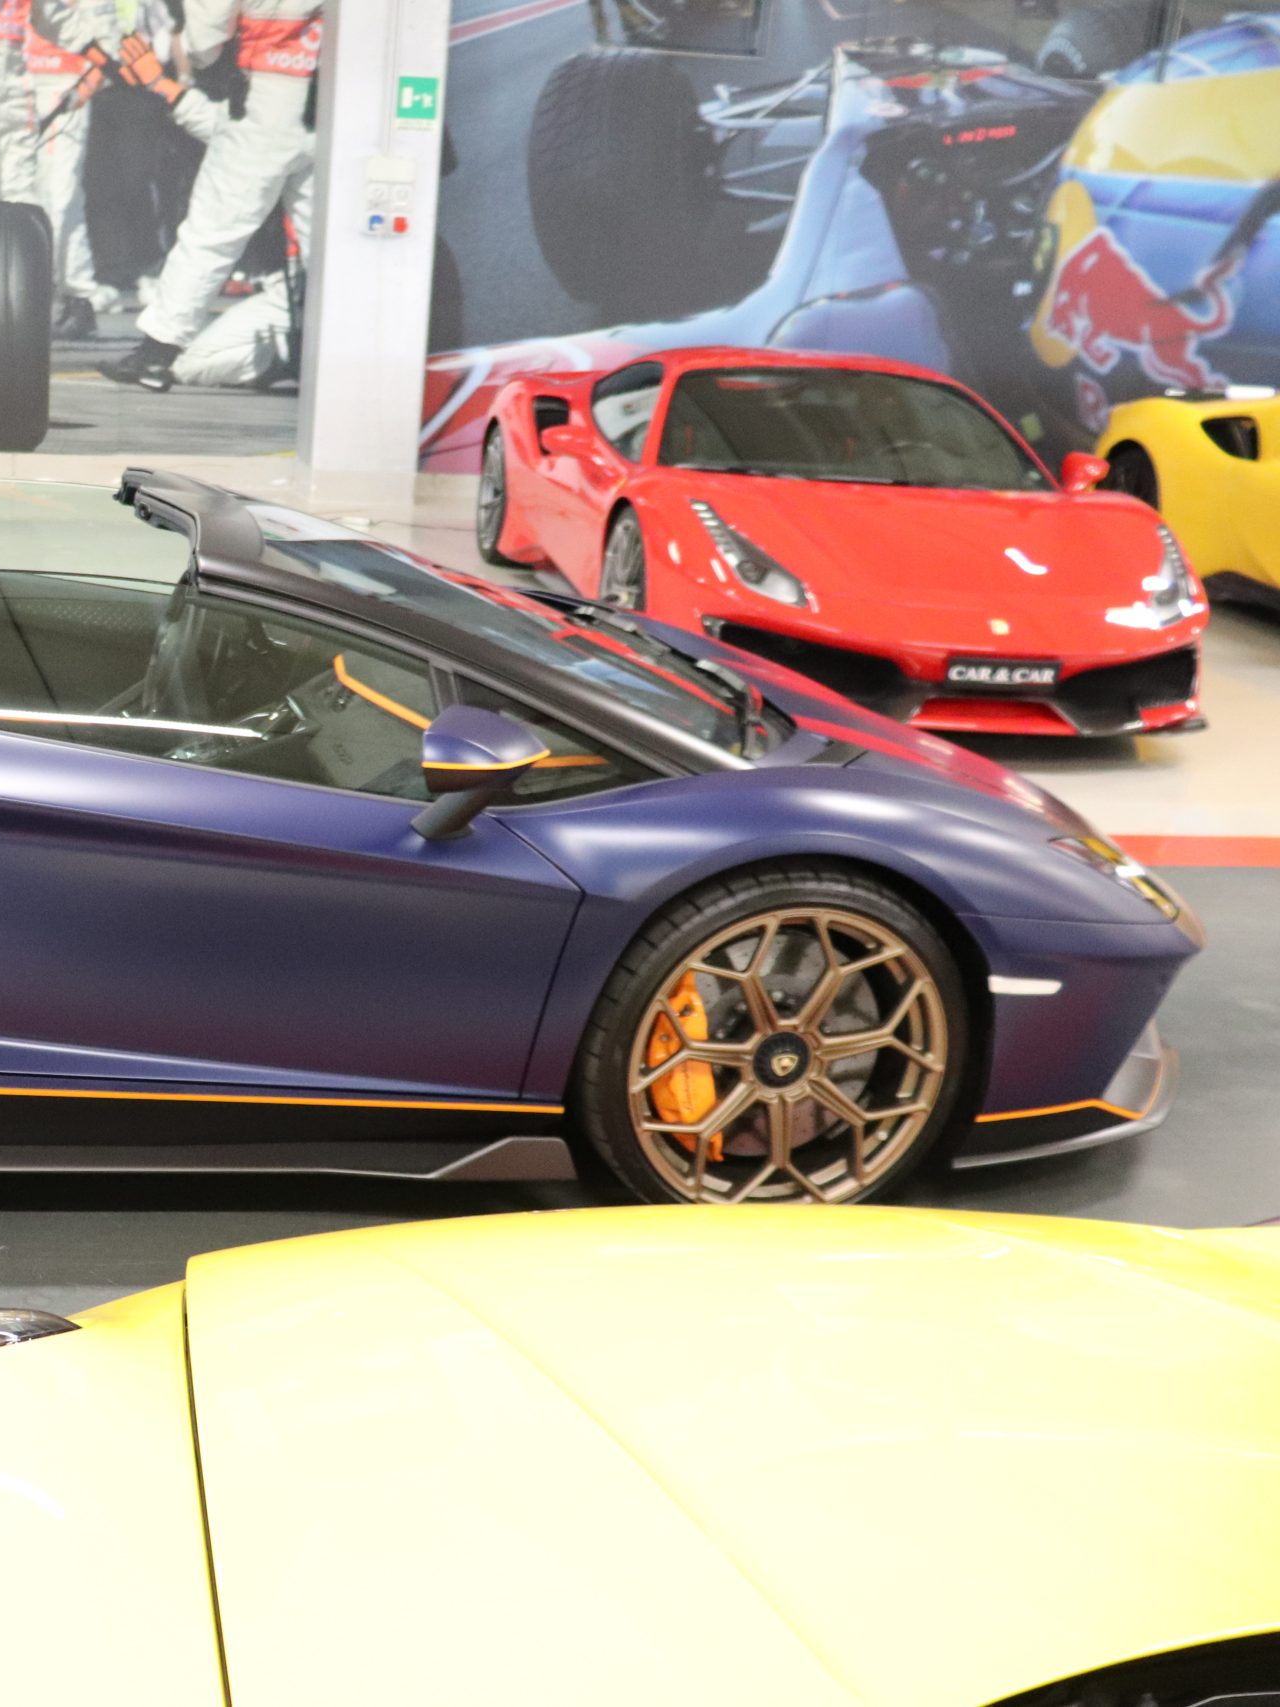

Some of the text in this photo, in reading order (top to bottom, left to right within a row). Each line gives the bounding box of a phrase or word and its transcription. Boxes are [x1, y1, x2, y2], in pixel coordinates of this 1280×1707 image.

[948, 665, 1056, 683] CAR & CAR
